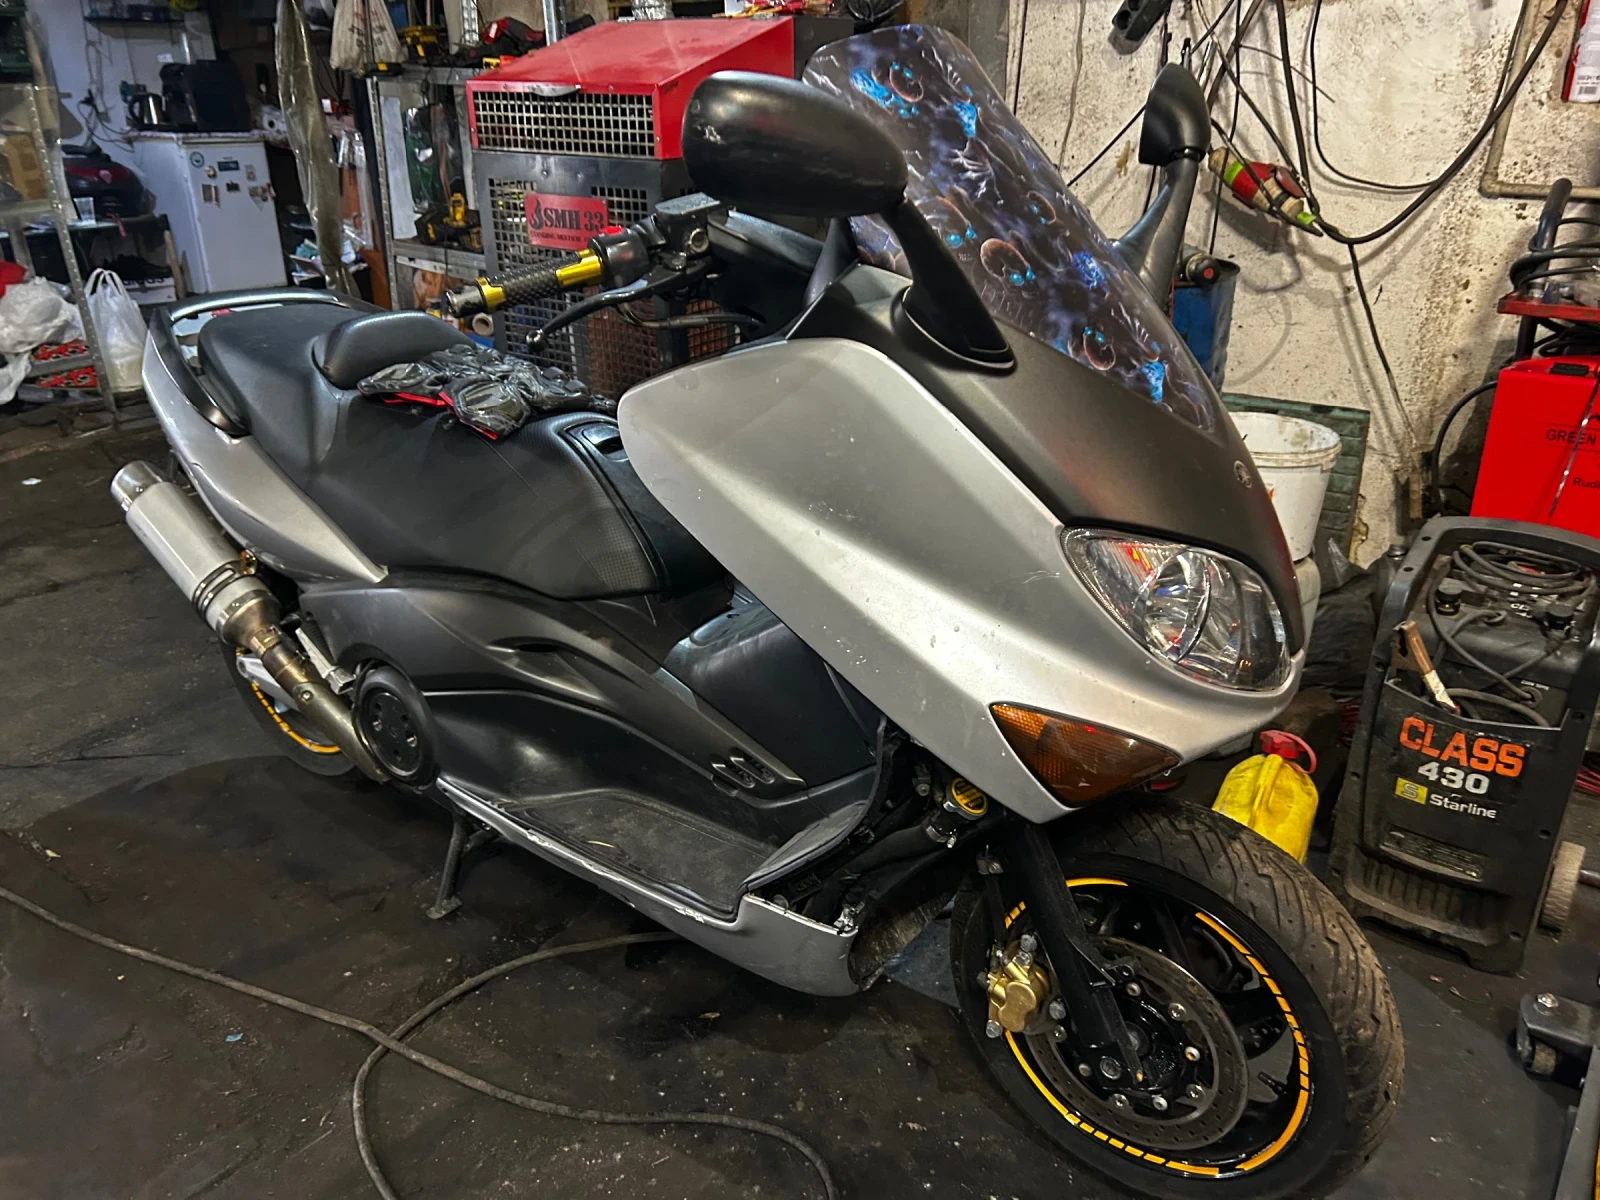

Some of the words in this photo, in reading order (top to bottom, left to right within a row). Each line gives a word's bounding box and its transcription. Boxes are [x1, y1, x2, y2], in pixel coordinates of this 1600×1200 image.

[544, 207, 581, 230] SMH
[583, 211, 605, 232] 33
[1545, 428, 1597, 446] GREEN
[1399, 716, 1525, 777] CLASS
[1418, 761, 1490, 794] 430
[1429, 794, 1497, 818] Starline
